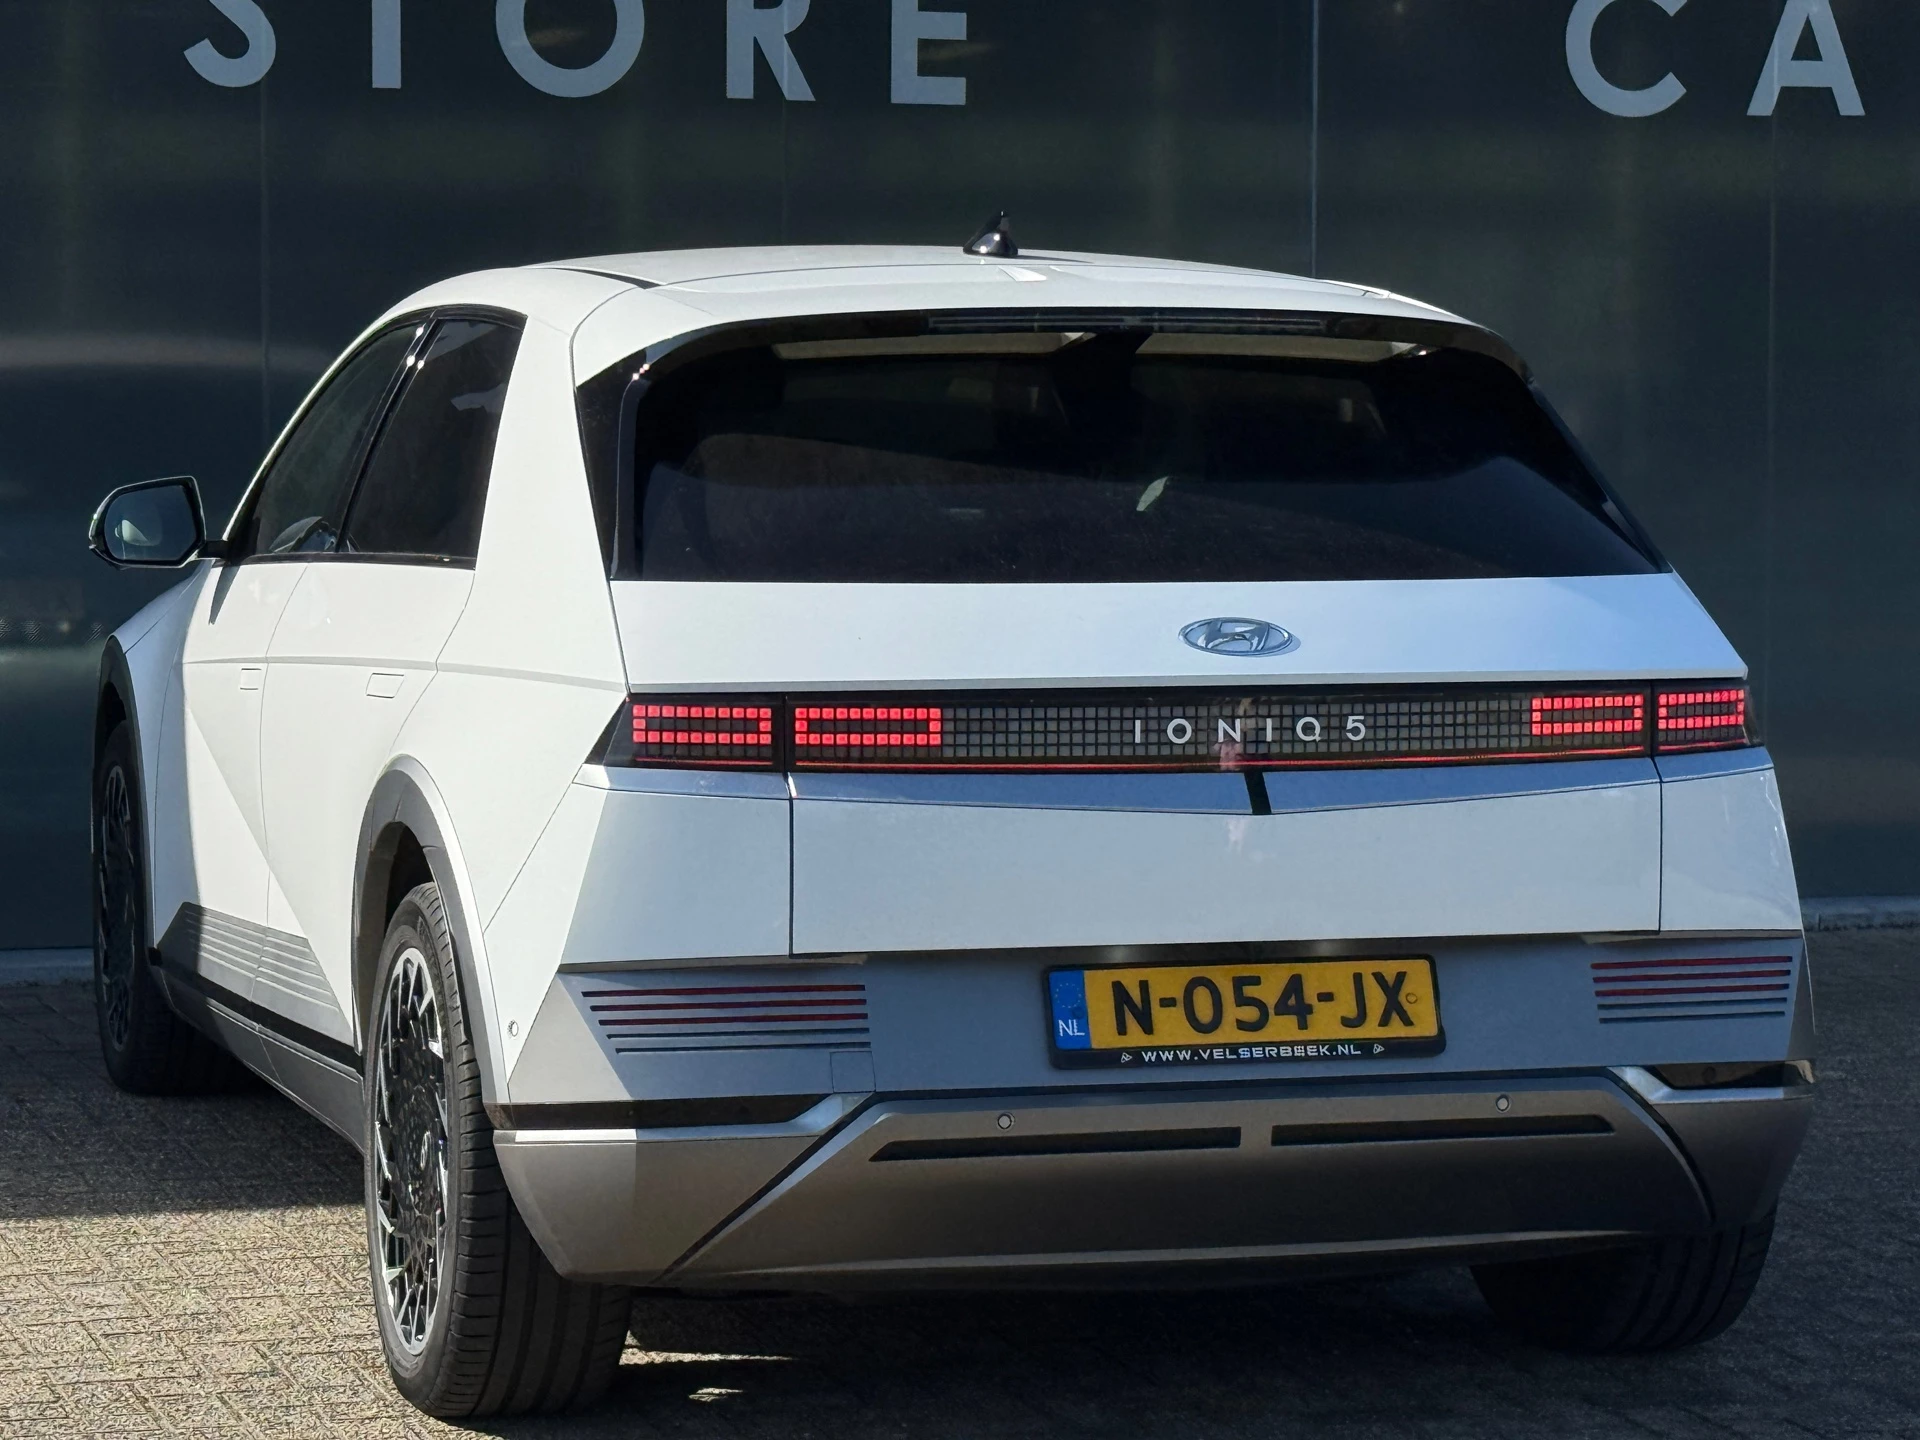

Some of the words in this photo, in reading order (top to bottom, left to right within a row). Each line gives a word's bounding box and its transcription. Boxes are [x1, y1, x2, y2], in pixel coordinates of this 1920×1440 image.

[1111, 971, 1415, 1036] N-054-JX
[1058, 1018, 1086, 1037] NL
[1141, 1044, 1362, 1062] WWW.VELSERBEEK.NL
